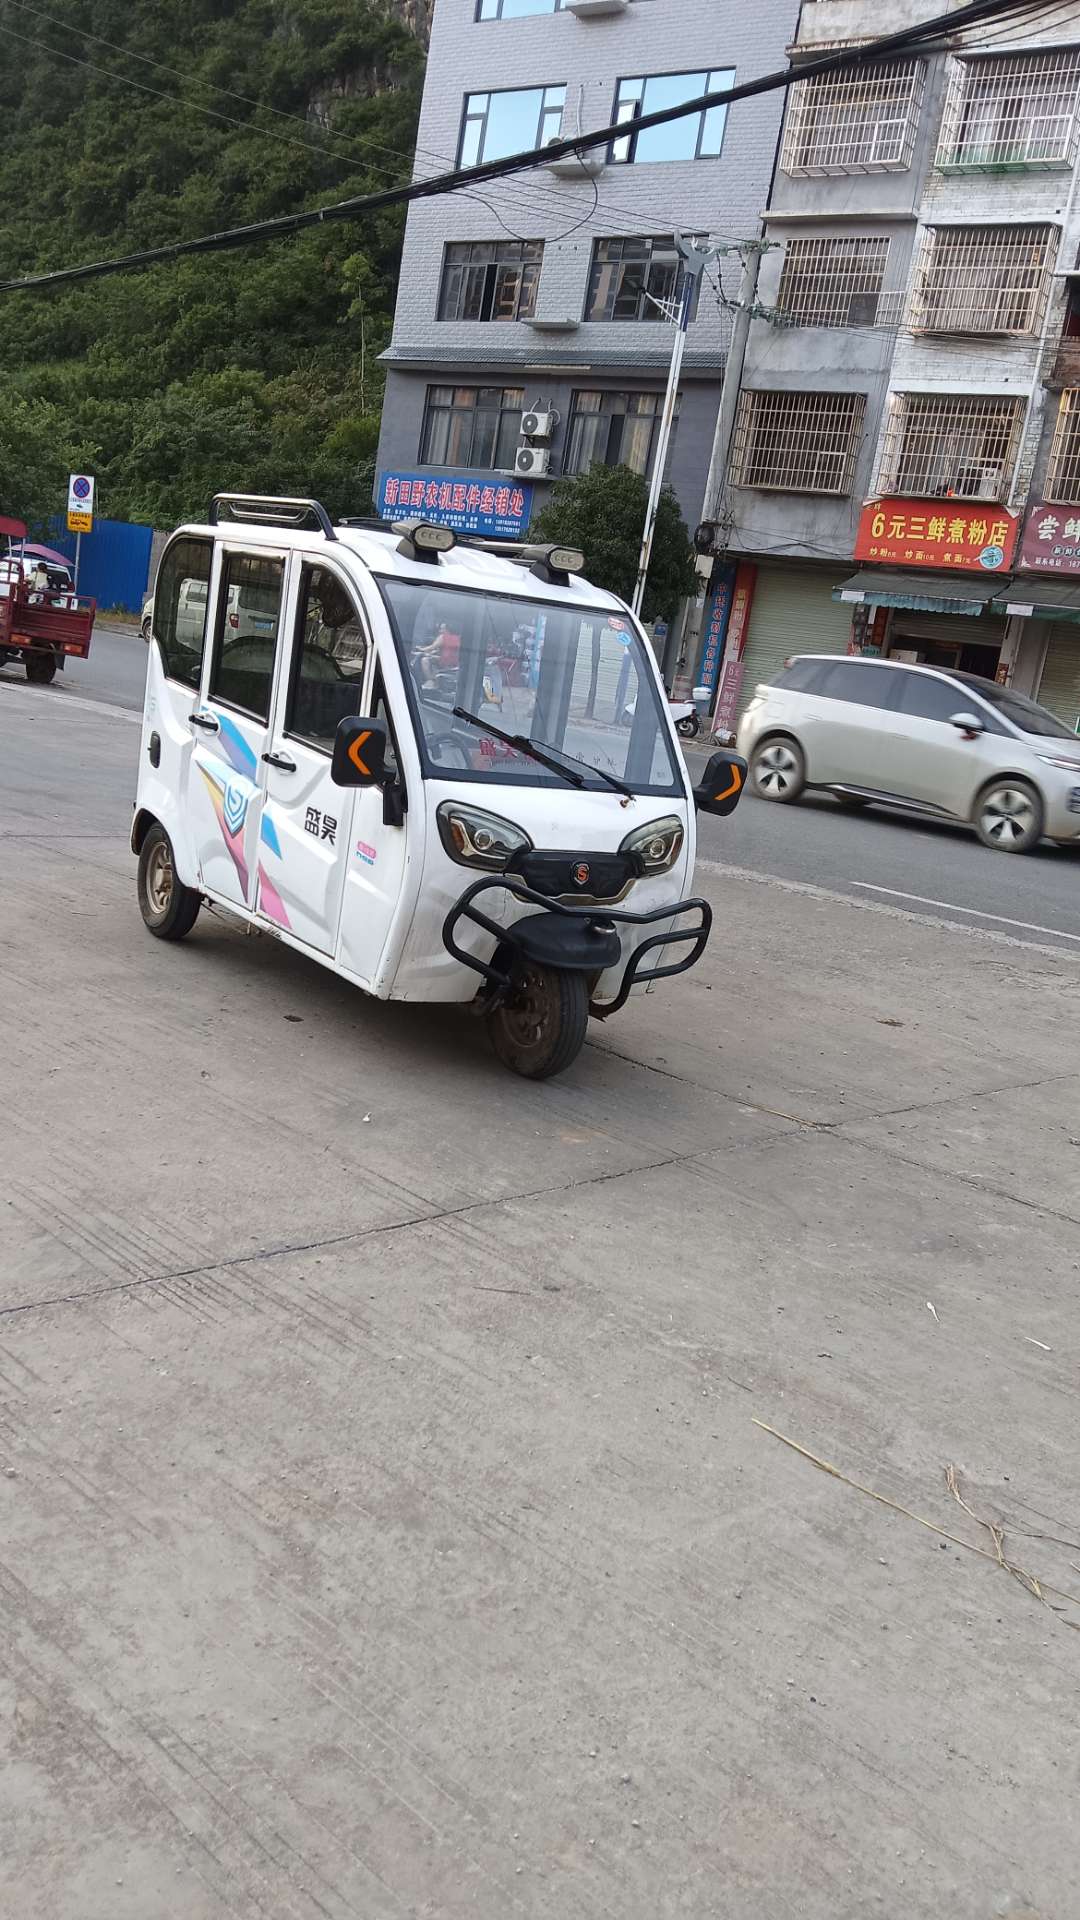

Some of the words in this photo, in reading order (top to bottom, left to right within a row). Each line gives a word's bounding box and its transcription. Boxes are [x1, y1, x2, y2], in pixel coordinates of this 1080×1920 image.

[384, 477, 524, 517] 新田野农机配件经销处
[871, 512, 1009, 547] 6元三鲜煮粉店
